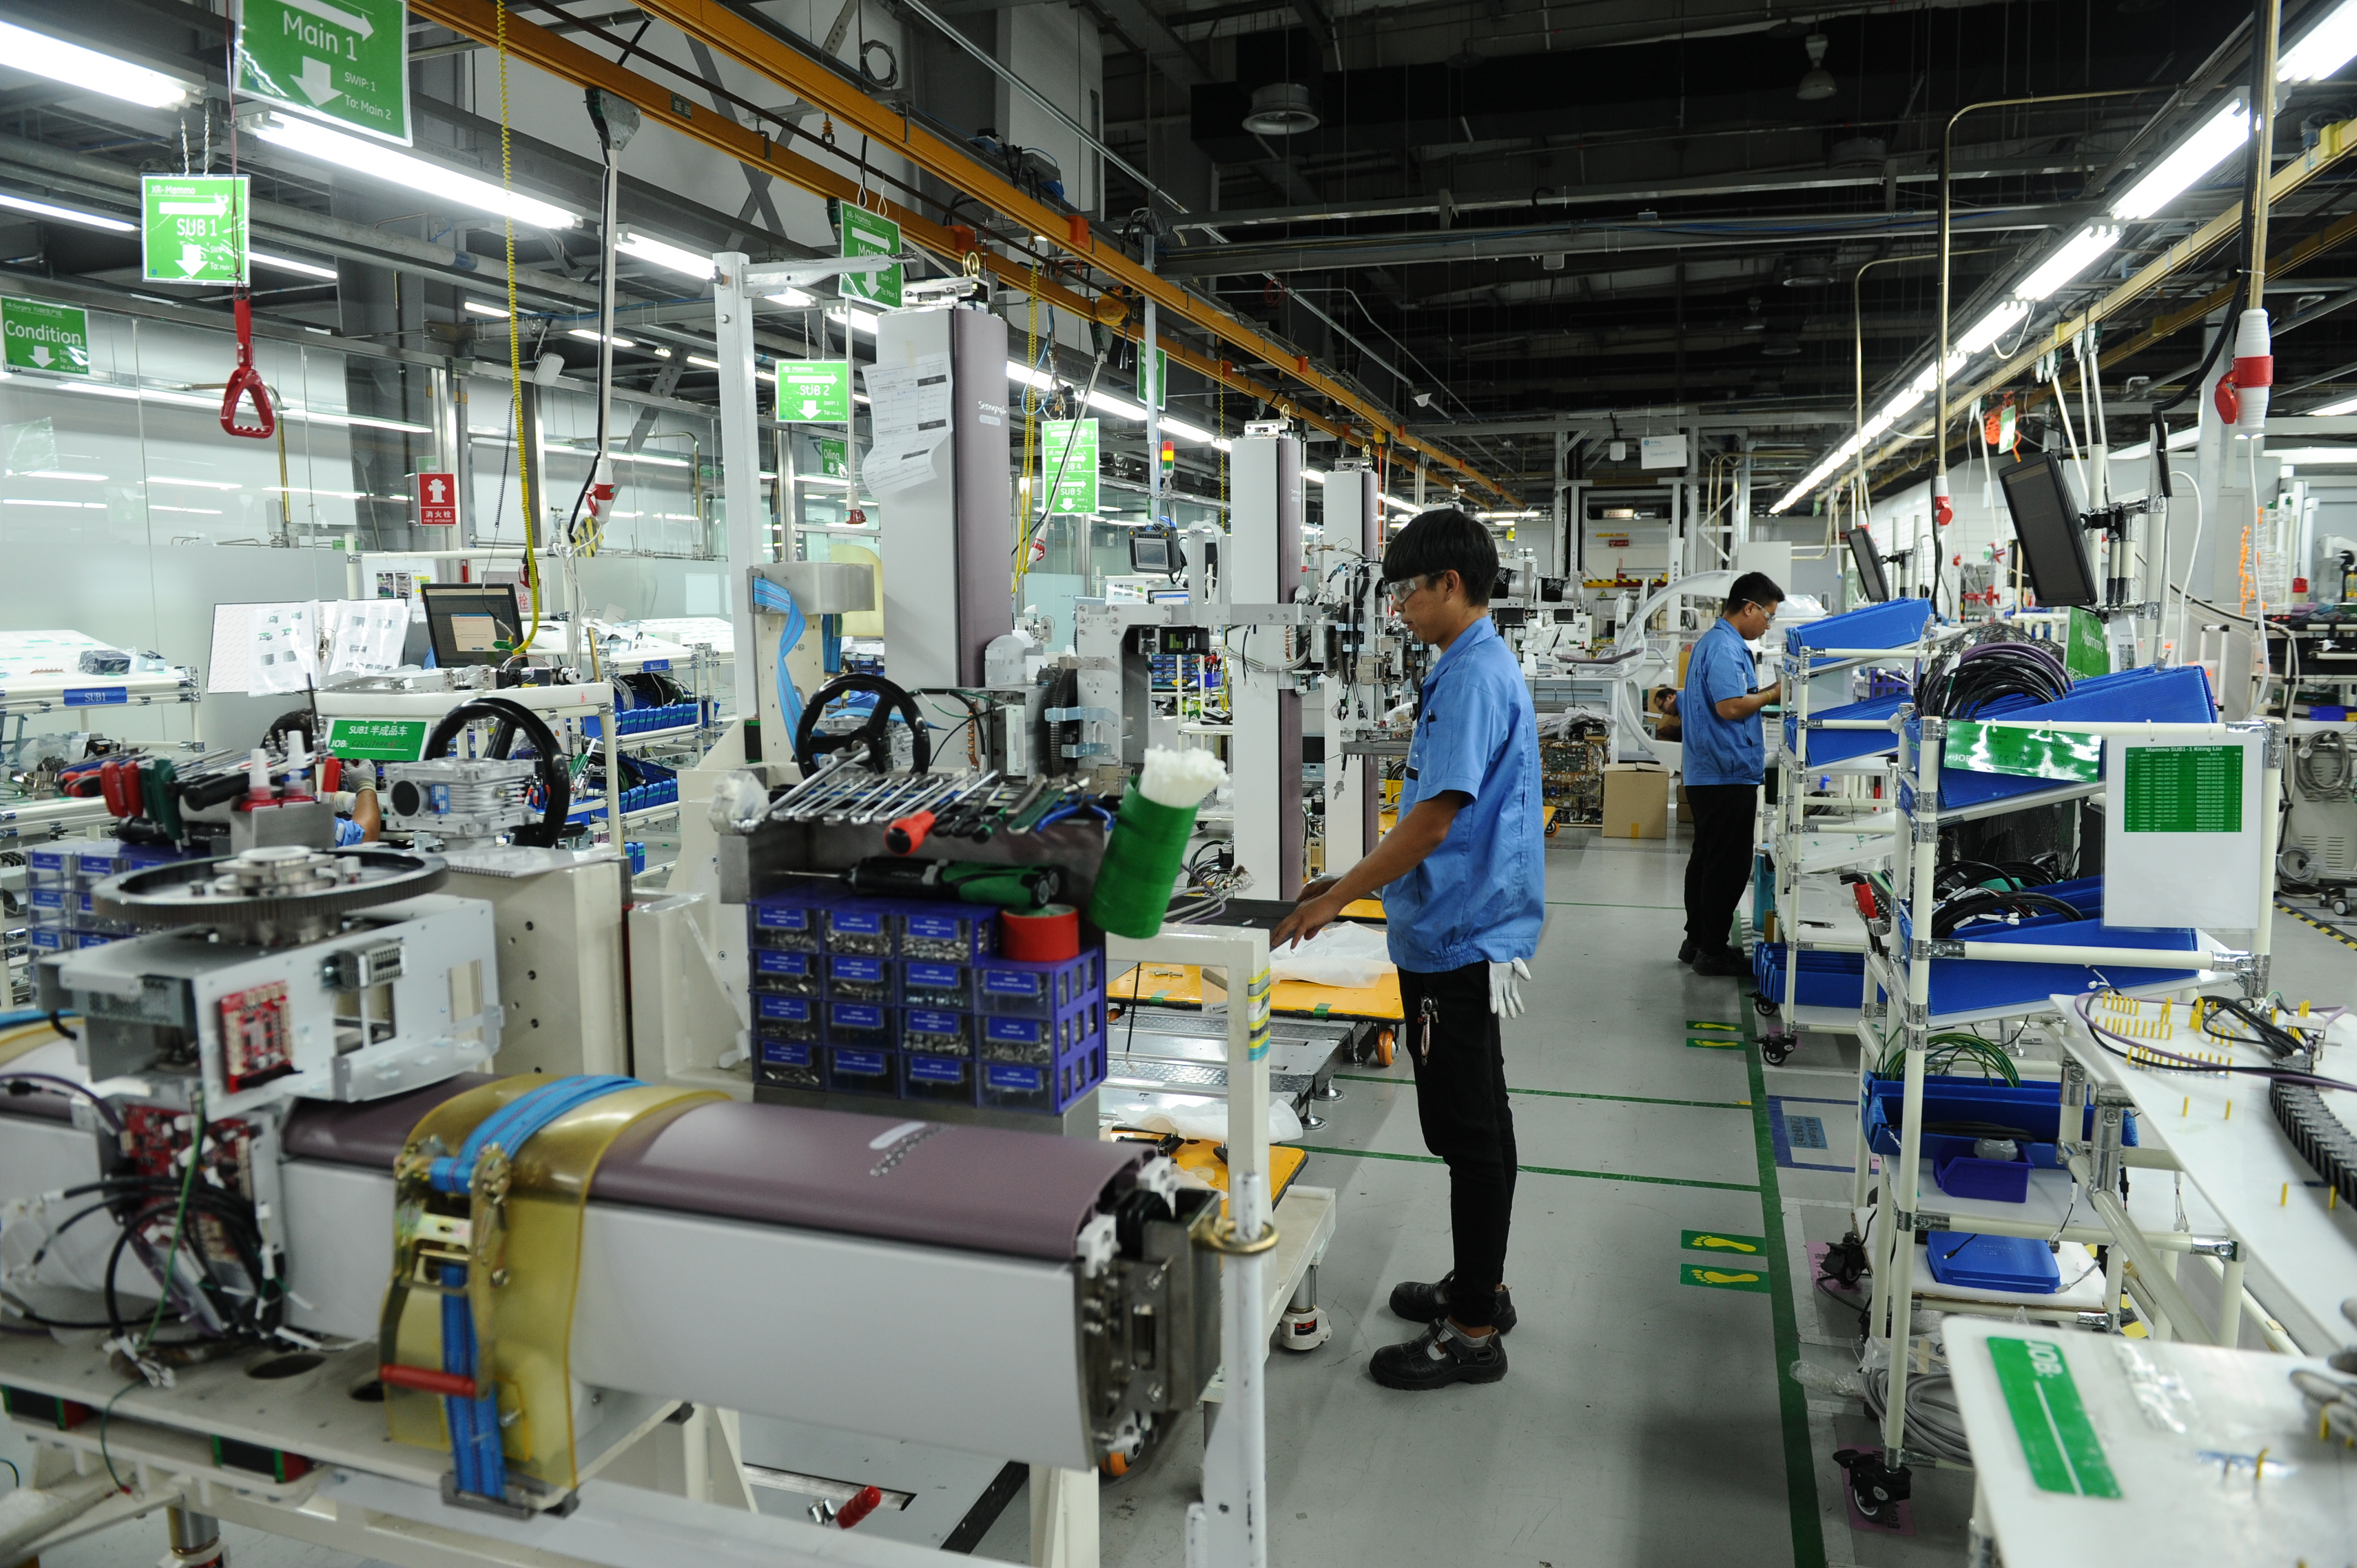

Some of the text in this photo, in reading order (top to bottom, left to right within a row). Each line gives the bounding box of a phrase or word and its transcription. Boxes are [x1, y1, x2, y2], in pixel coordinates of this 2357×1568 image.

[283, 10, 357, 61] Main 1
[344, 72, 375, 92] SWIP: 1
[344, 94, 391, 120] To: Main 2
[165, 185, 195, 195] Mammo
[855, 212, 872, 226] Mammo
[176, 218, 217, 237] SUB 1
[210, 262, 219, 271] To:
[5, 320, 81, 345] Condition
[799, 384, 830, 396] SUB 2
[426, 510, 451, 518] 消火栓
[2081, 630, 2104, 653] Mammo
[85, 692, 106, 703] SUB1
[348, 724, 409, 737] SUB1 半成品车
[330, 739, 348, 748] JOB:
